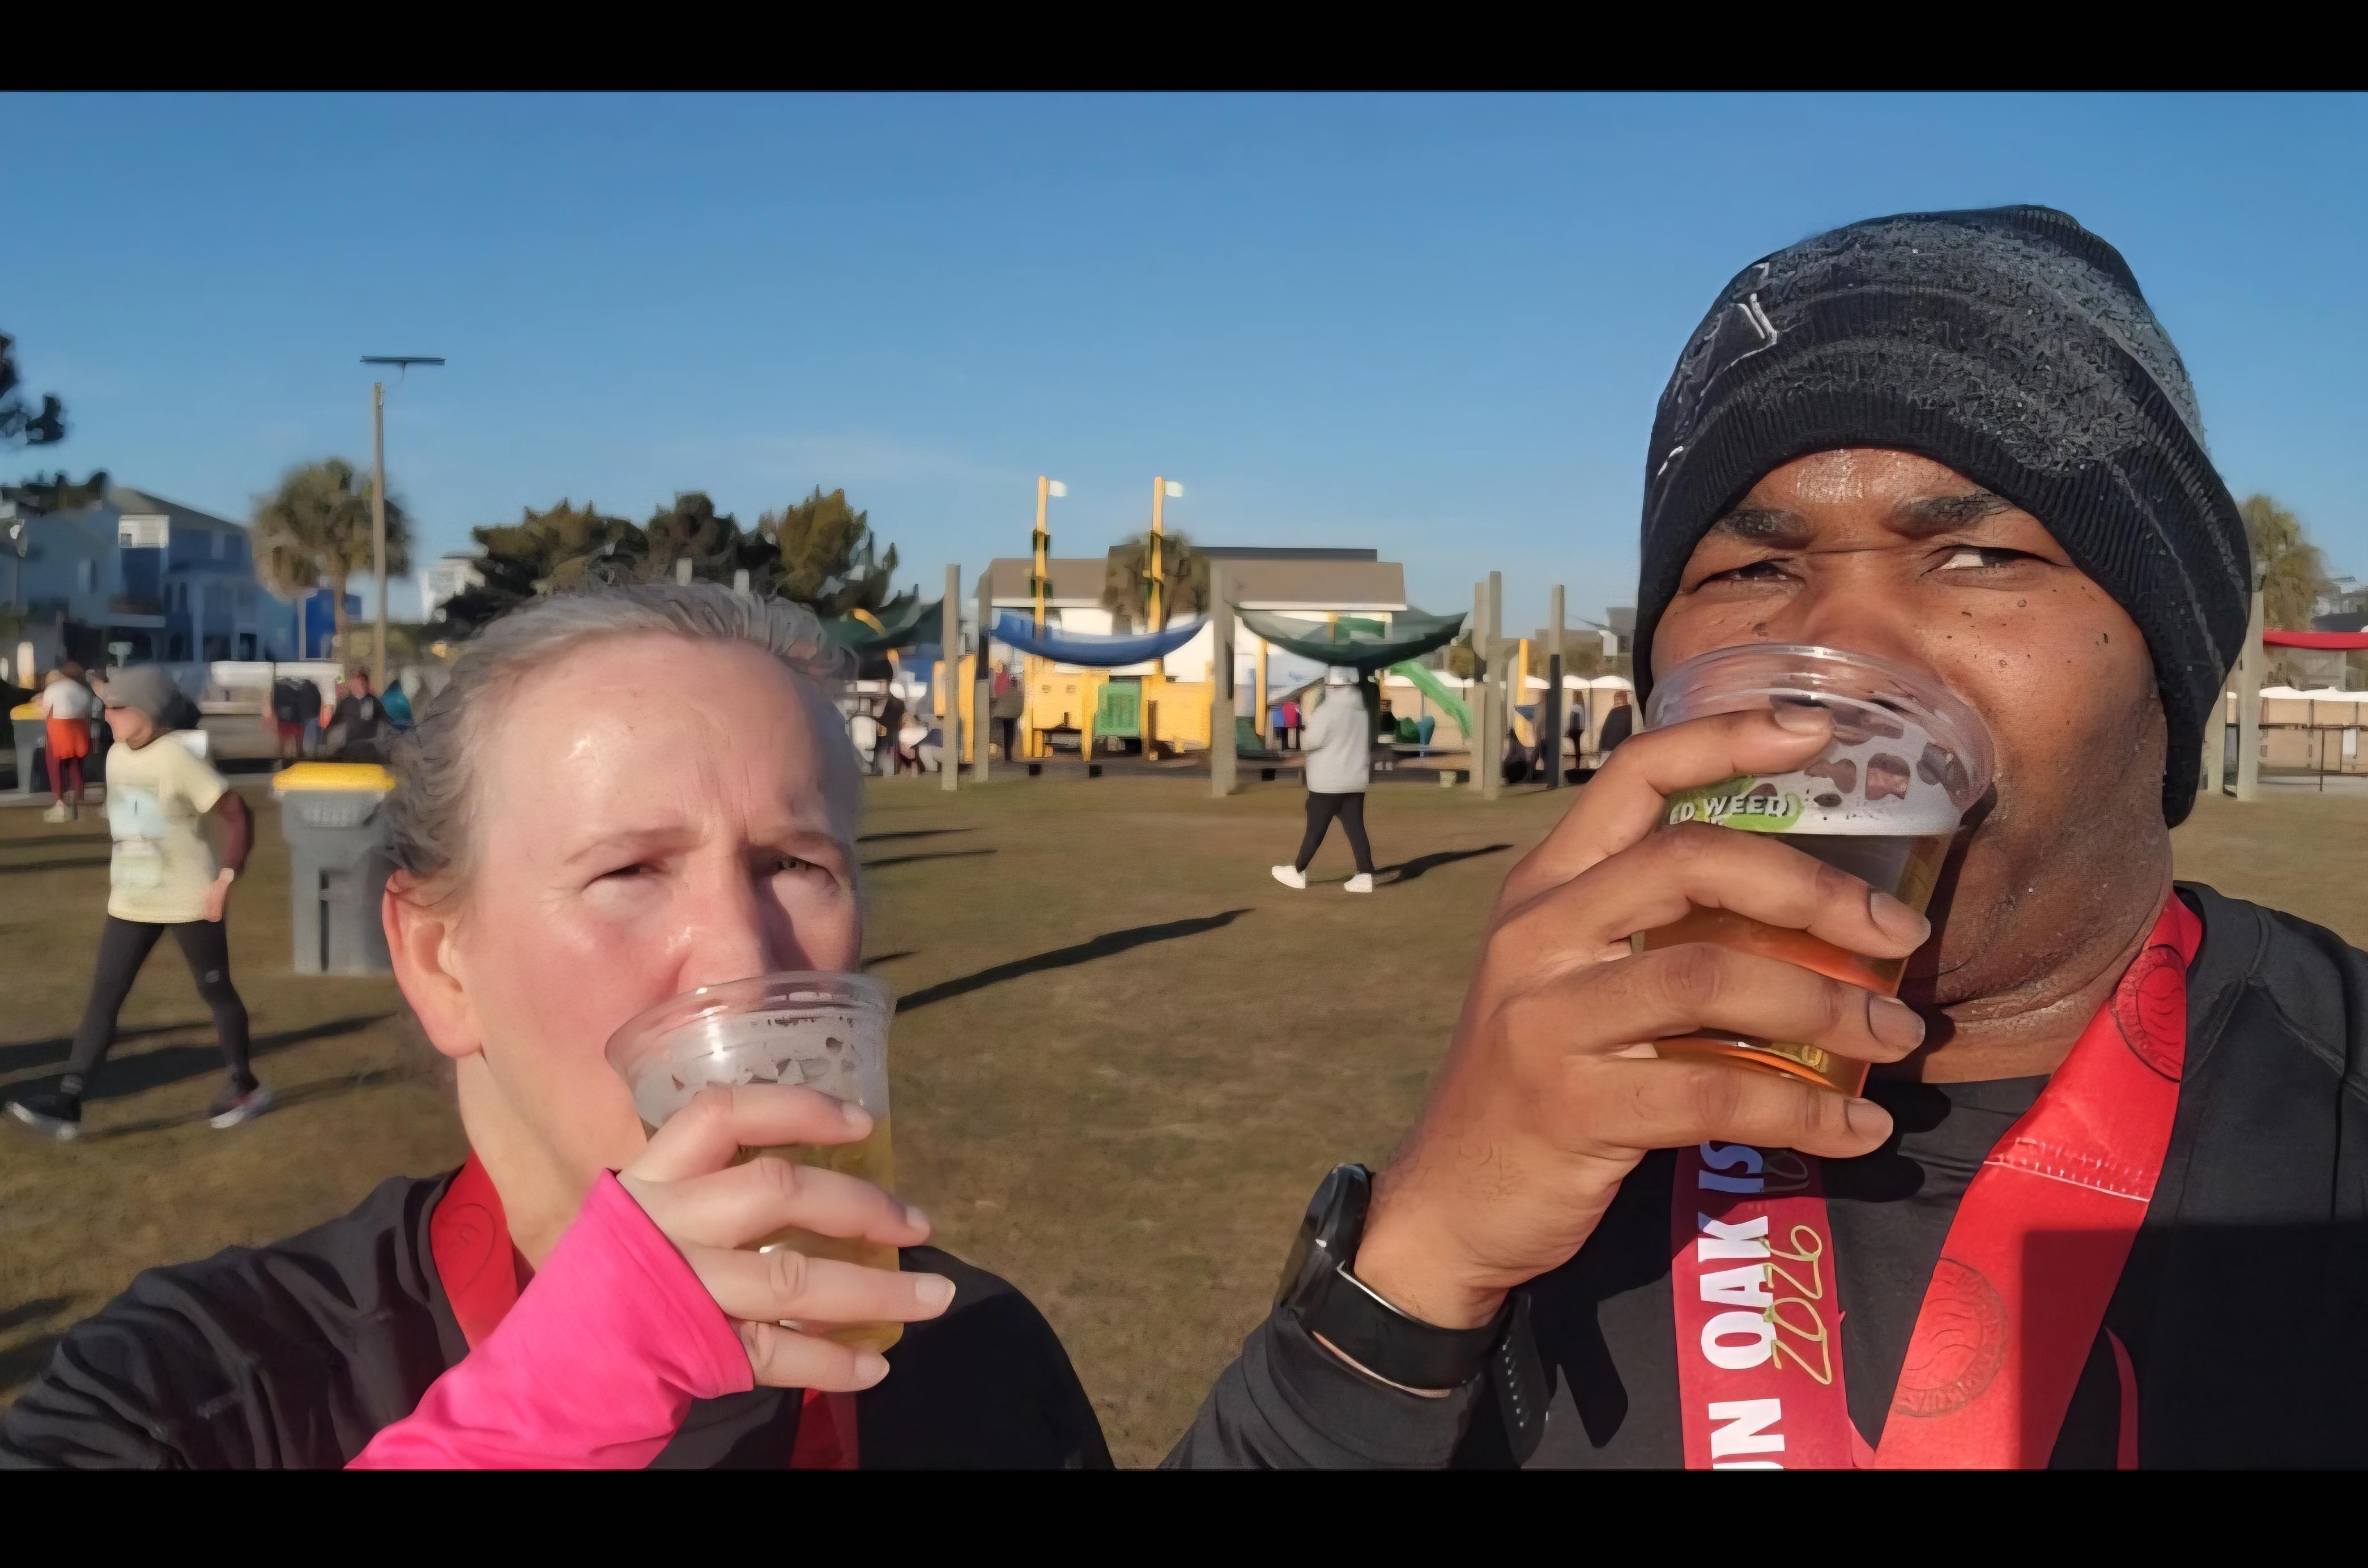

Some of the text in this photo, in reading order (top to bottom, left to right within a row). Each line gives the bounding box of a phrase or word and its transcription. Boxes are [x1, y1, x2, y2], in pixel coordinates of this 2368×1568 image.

[1705, 795, 1788, 818] WEED
[1698, 1212, 1777, 1369] OAK
[1761, 1225, 1832, 1384] 2026
[1708, 1398, 1784, 1469] N
